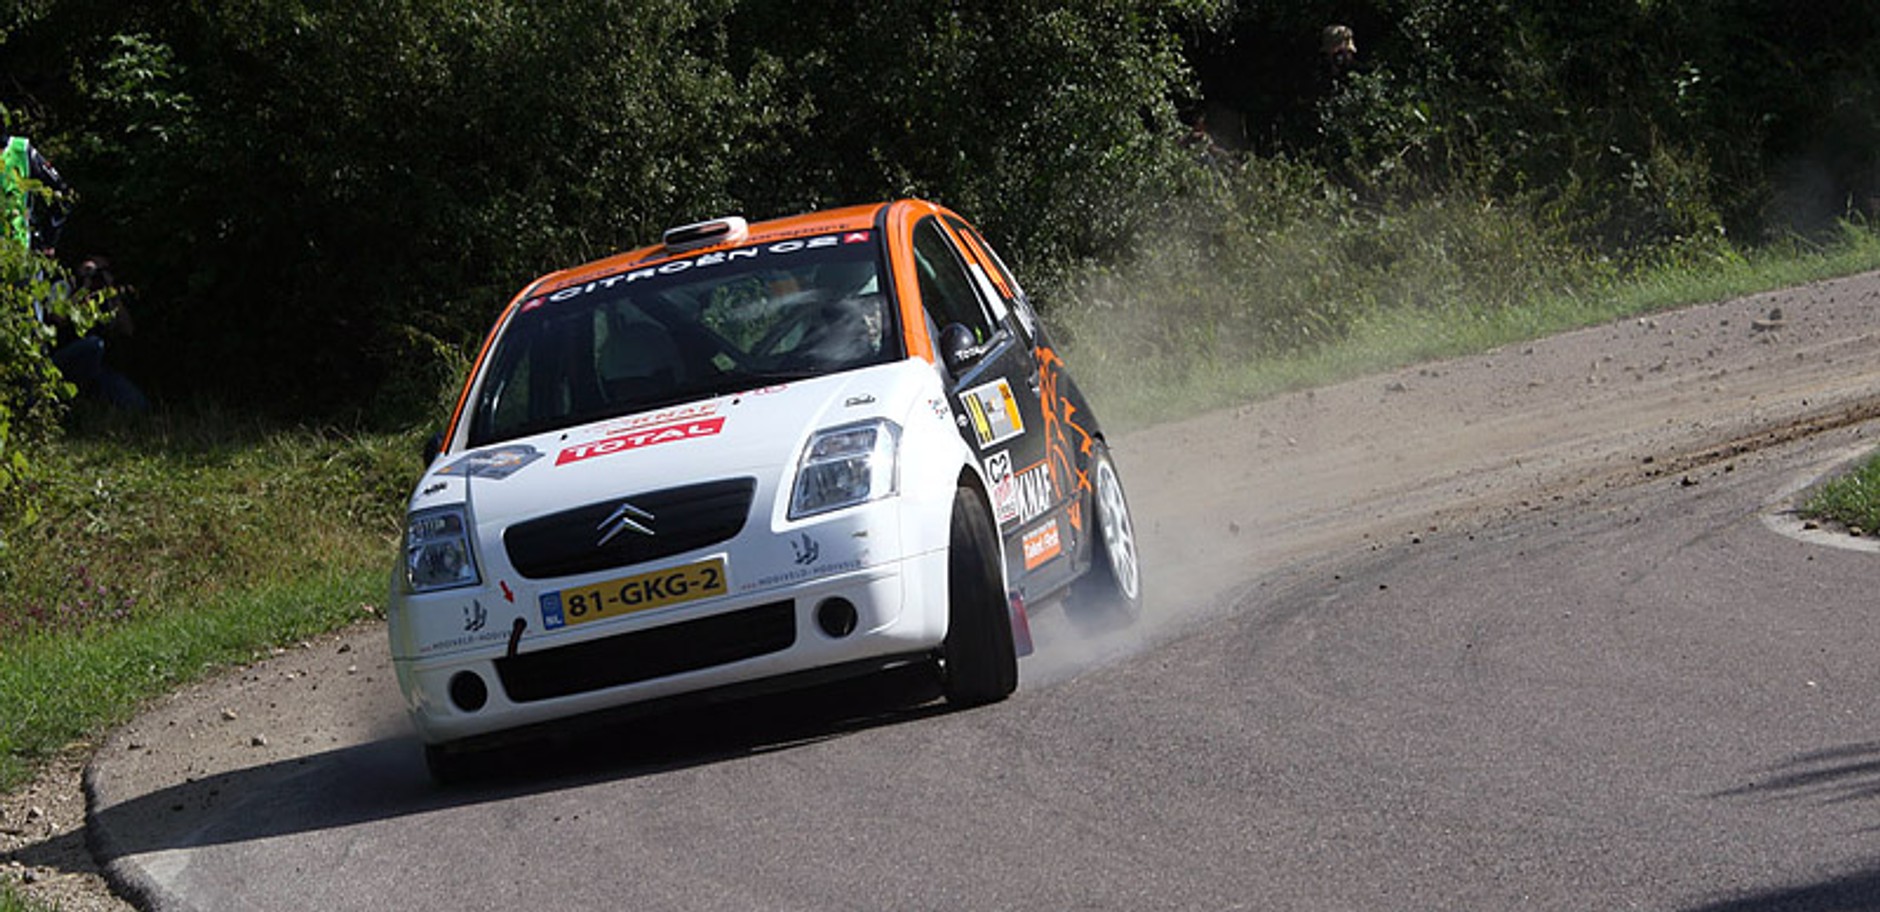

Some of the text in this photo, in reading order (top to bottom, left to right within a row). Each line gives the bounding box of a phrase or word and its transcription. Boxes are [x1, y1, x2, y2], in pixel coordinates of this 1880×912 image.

[550, 246, 759, 301] CITROËN
[768, 235, 839, 254] C2
[565, 423, 716, 459] TOTAL
[989, 453, 1008, 484] C2
[1014, 463, 1052, 525] KNAF
[568, 567, 721, 617] 81-GKG-2
[545, 615, 563, 626] NL
